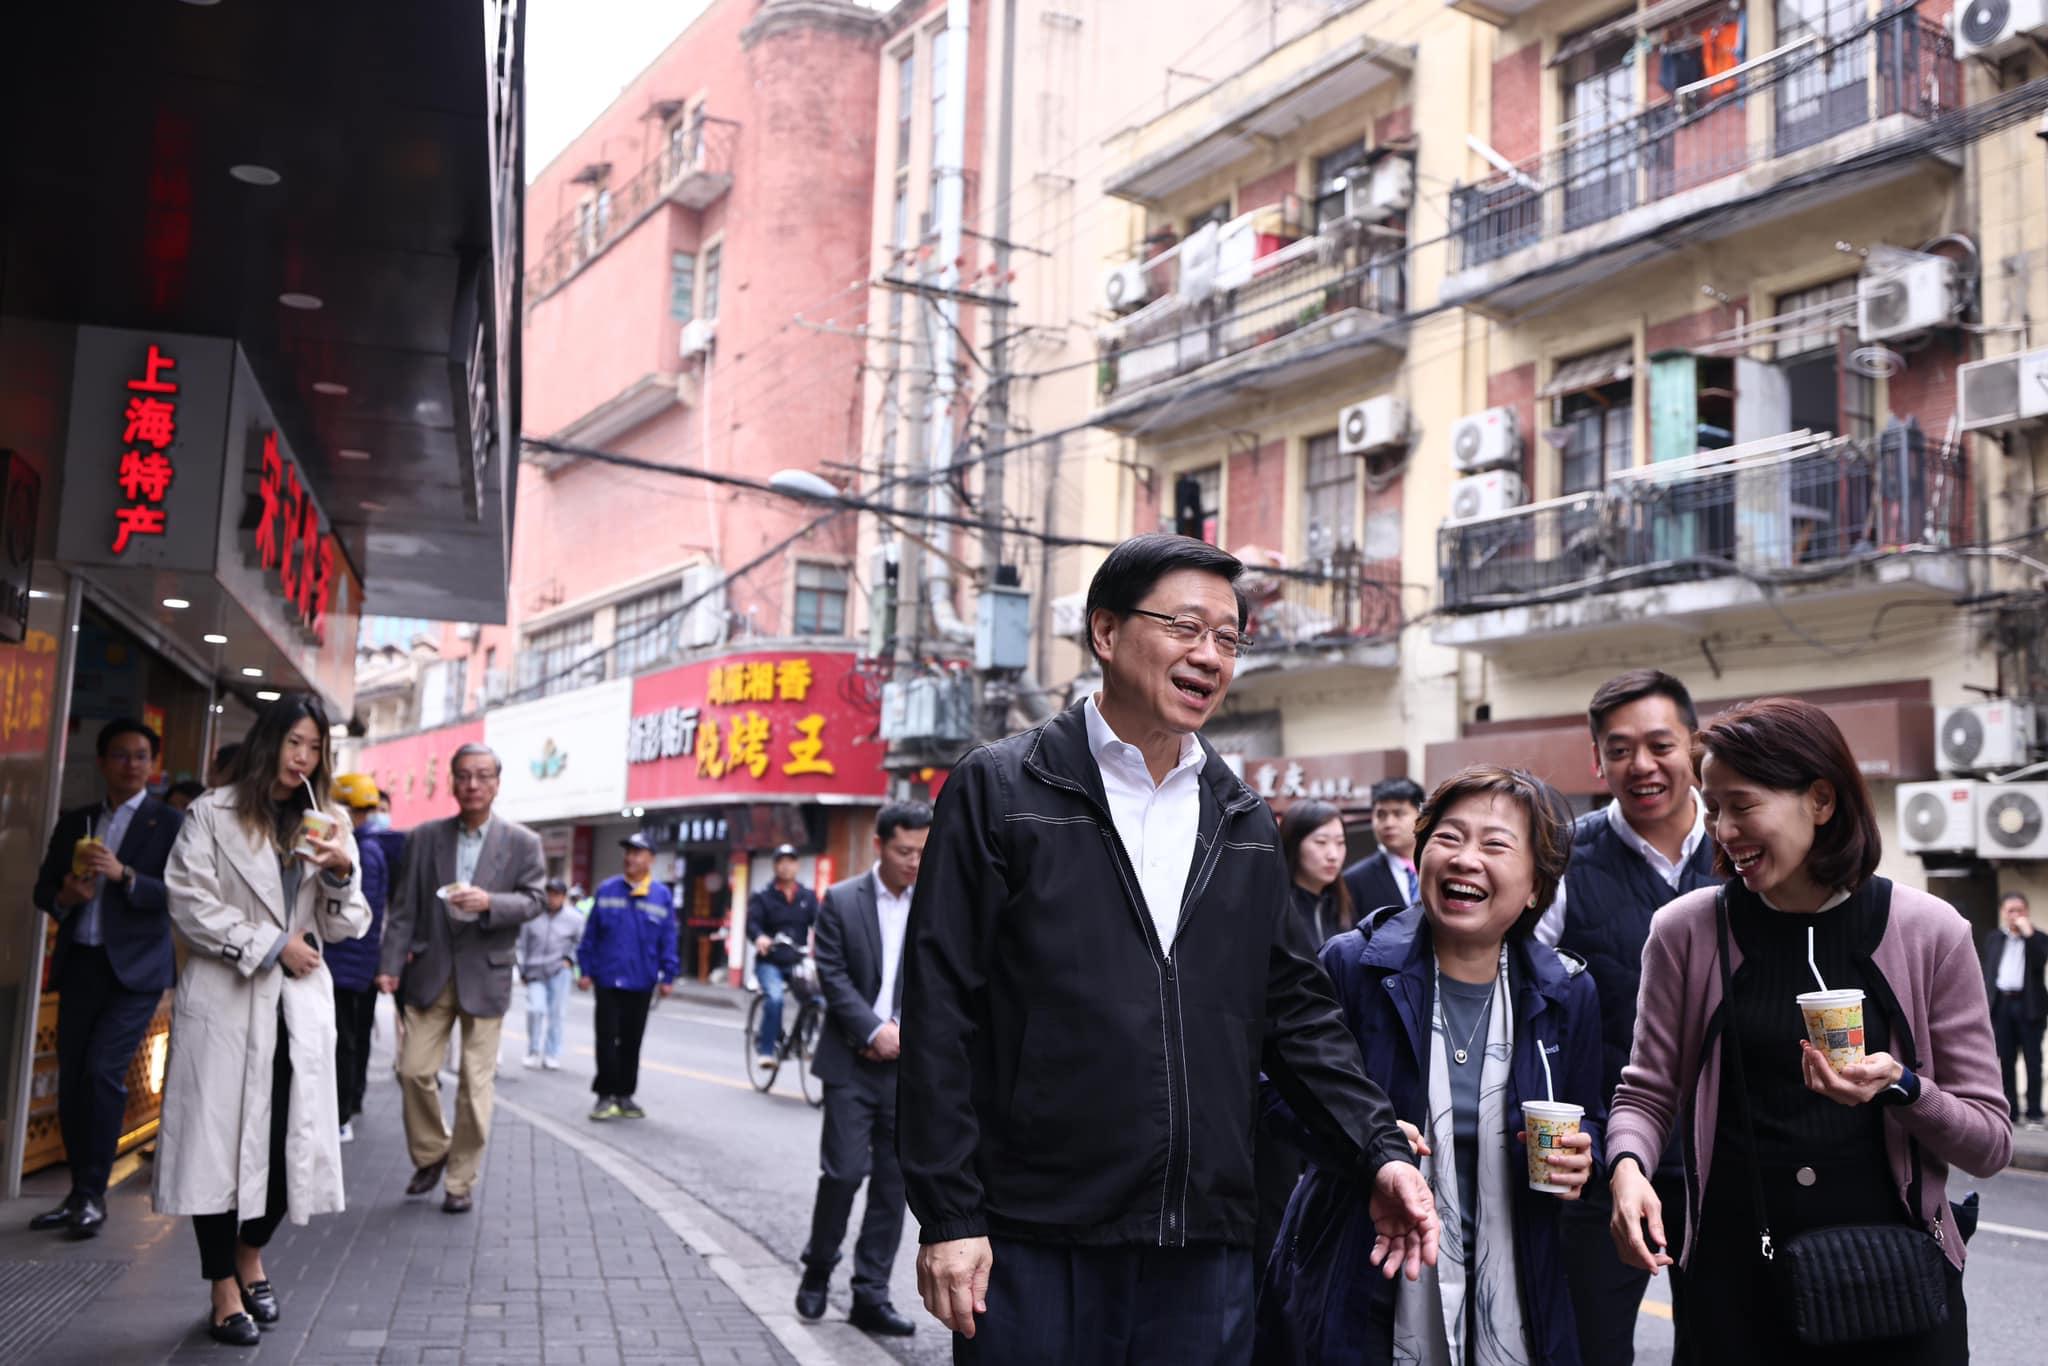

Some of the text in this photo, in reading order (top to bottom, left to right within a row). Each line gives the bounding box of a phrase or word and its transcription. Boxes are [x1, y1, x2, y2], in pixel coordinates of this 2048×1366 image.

[111, 344, 178, 555] 上海特产
[695, 709, 836, 779] 烧烤王
